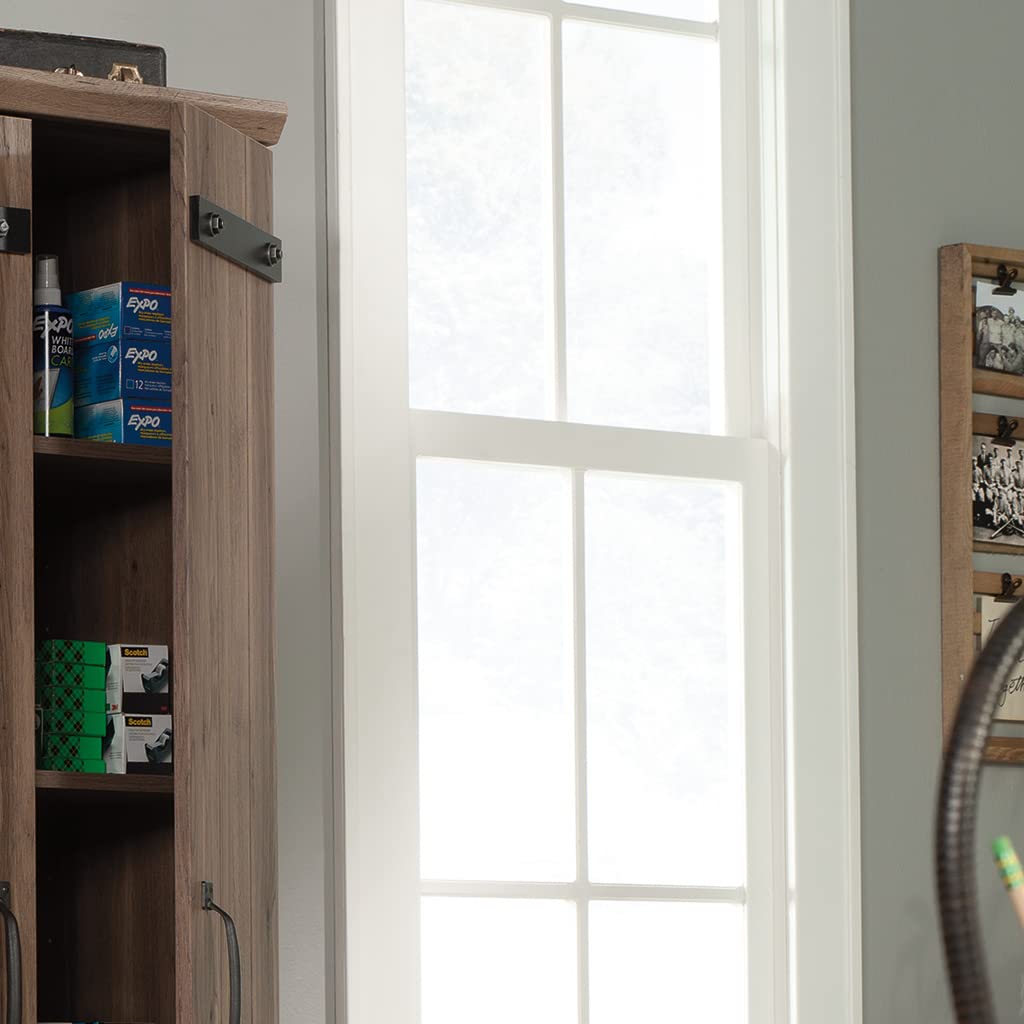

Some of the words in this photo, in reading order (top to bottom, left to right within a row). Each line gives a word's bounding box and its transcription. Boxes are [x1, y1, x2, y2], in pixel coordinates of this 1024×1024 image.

[126, 297, 158, 313] EXPO
[125, 347, 158, 364] EXPO
[135, 379, 144, 390] 12
[128, 414, 160, 431] EXPO
[124, 648, 148, 657] Scotch
[128, 717, 152, 726] Scotch
